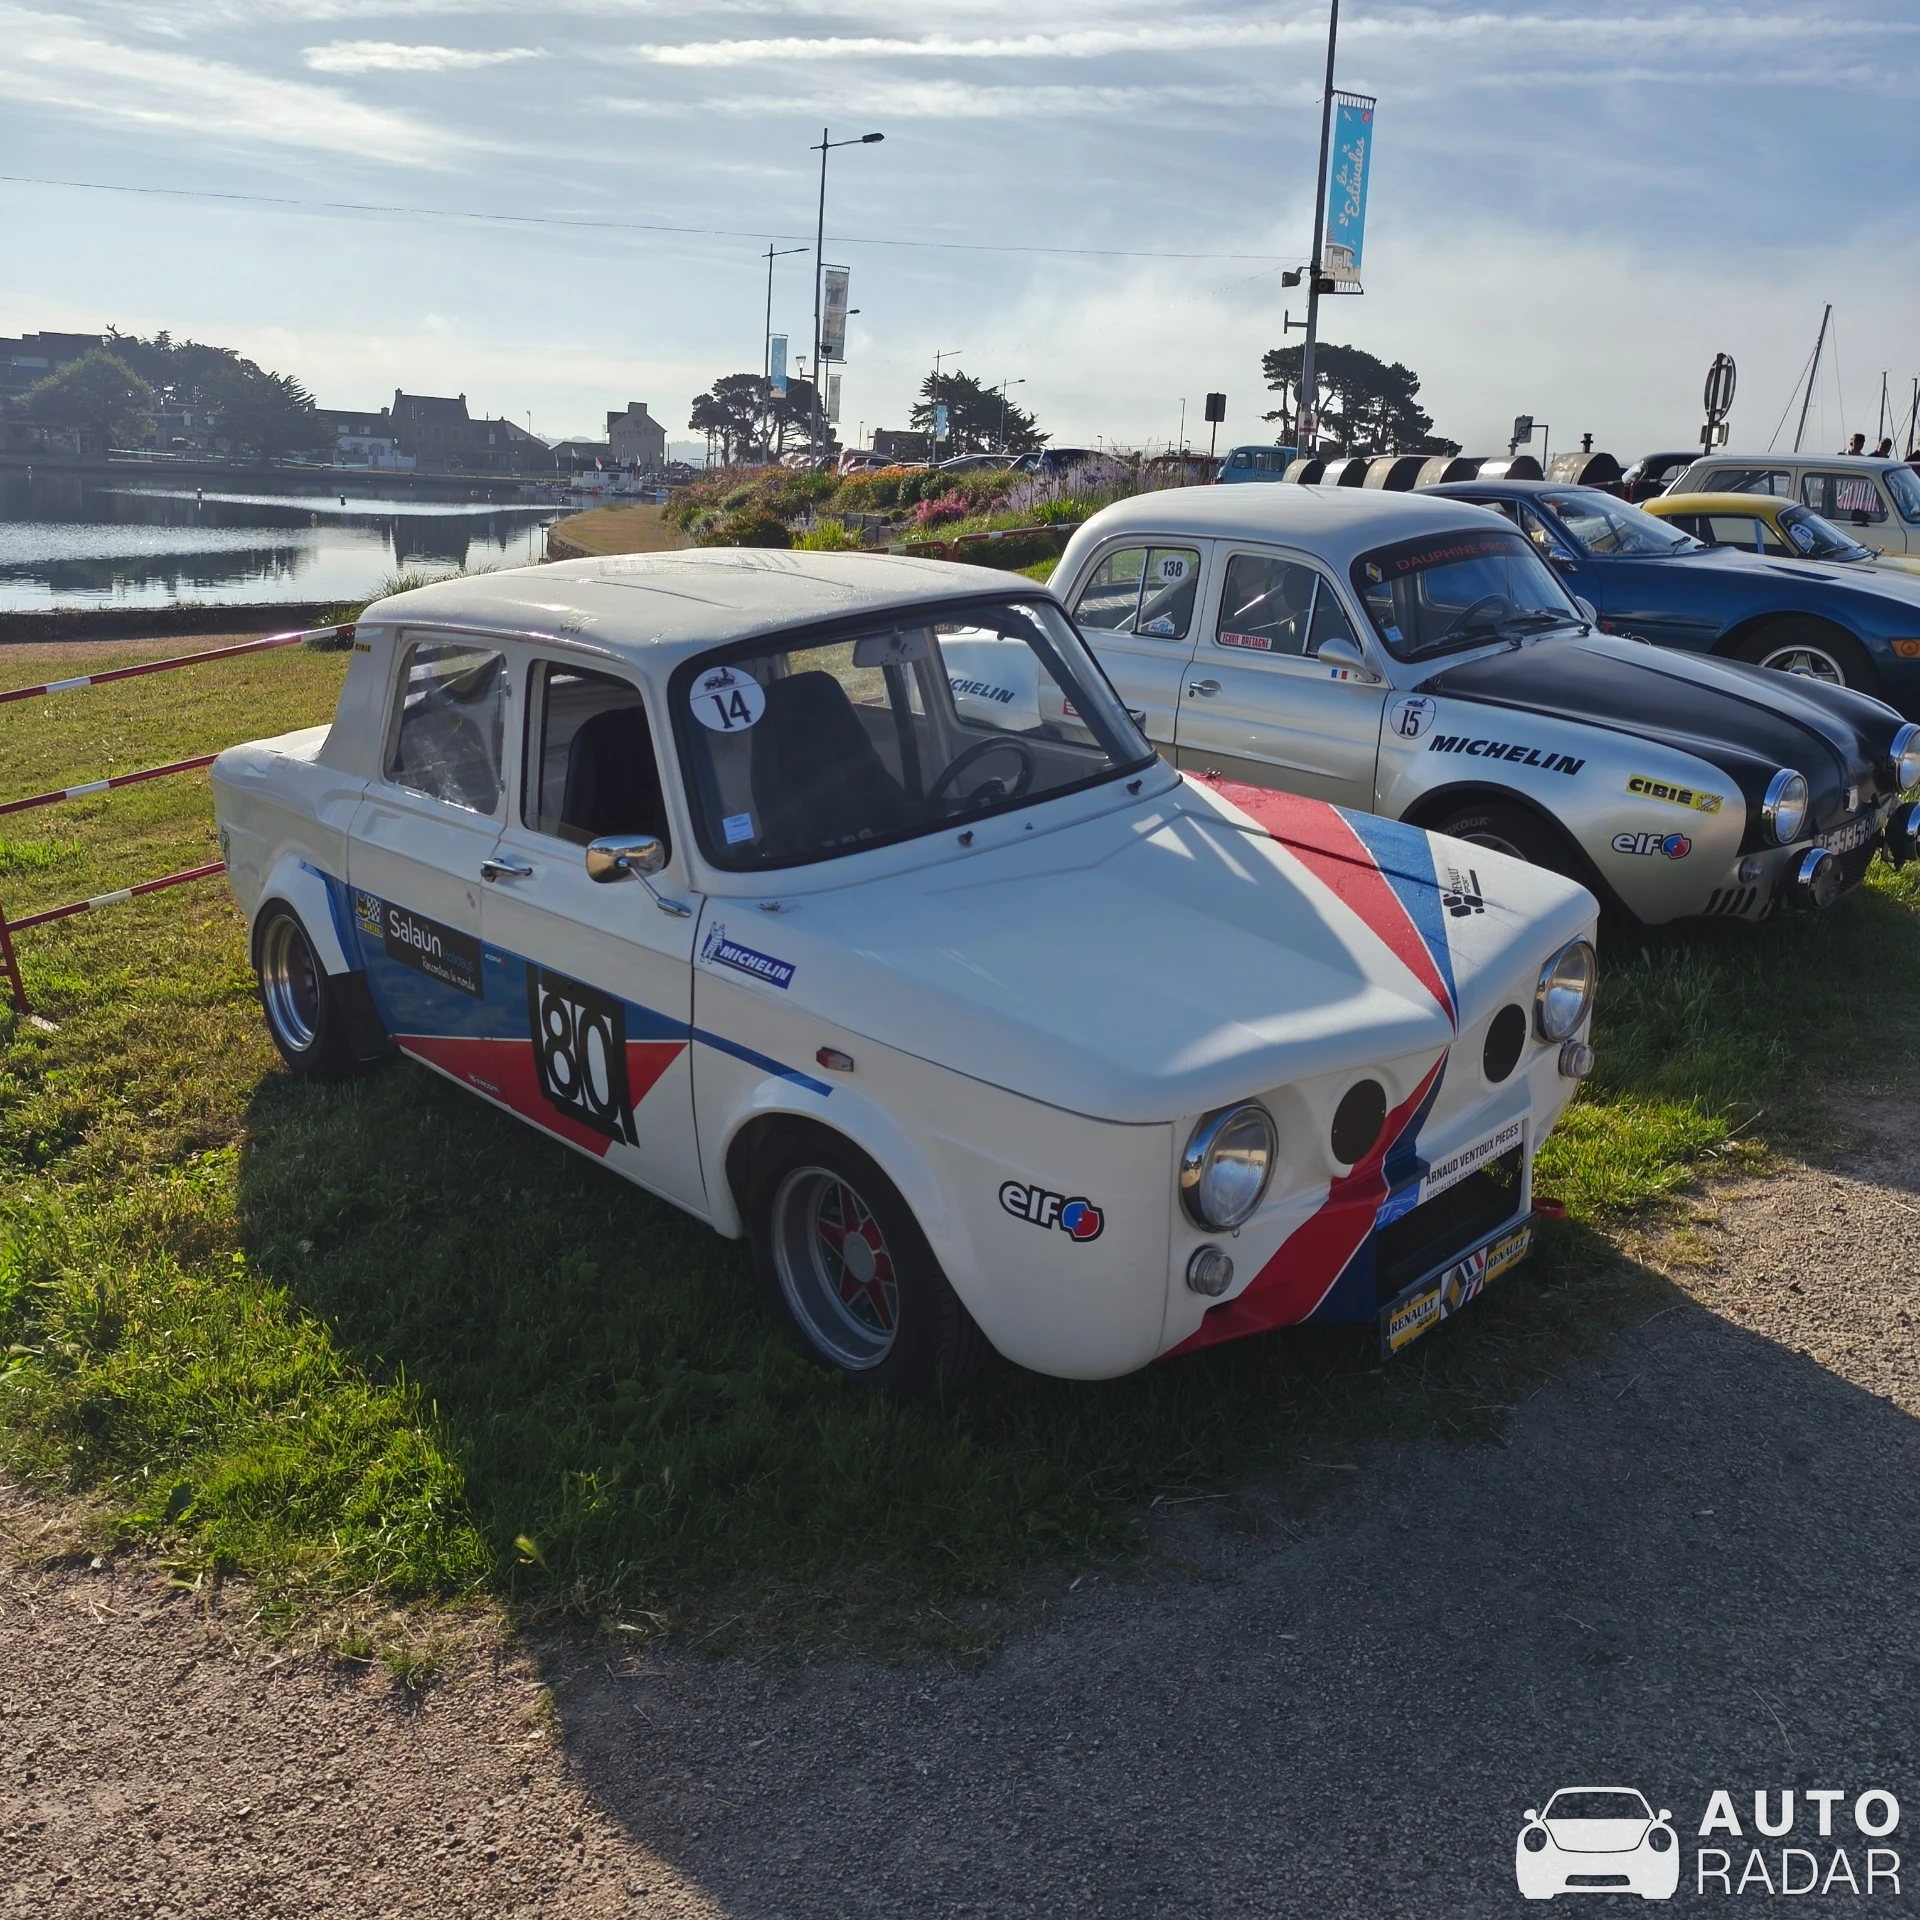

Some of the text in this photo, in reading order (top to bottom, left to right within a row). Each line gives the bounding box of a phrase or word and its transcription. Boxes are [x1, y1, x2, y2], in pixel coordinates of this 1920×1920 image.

[1345, 137, 1364, 217] Estivales
[1163, 560, 1184, 577] 138
[1396, 544, 1479, 570] DAUPHINE
[1241, 635, 1269, 649] BRETAGNE
[950, 678, 1015, 704] CHELIN
[711, 690, 752, 729] 14
[1400, 709, 1422, 736] 15
[1428, 735, 1586, 775] MICHELIN
[1612, 832, 1663, 856] elf
[1447, 867, 1464, 895] RENAULT
[719, 945, 791, 980] MICHELIN
[541, 992, 620, 1122] 80
[1426, 1158, 1459, 1187] ARNAUD
[1460, 1139, 1494, 1167] VENTOUX
[1000, 1181, 1064, 1229] elf
[1426, 1177, 1458, 1199] SPÉCIALISTE
[1487, 1236, 1526, 1270] RENAULT
[1390, 1297, 1435, 1334] RENAULT
